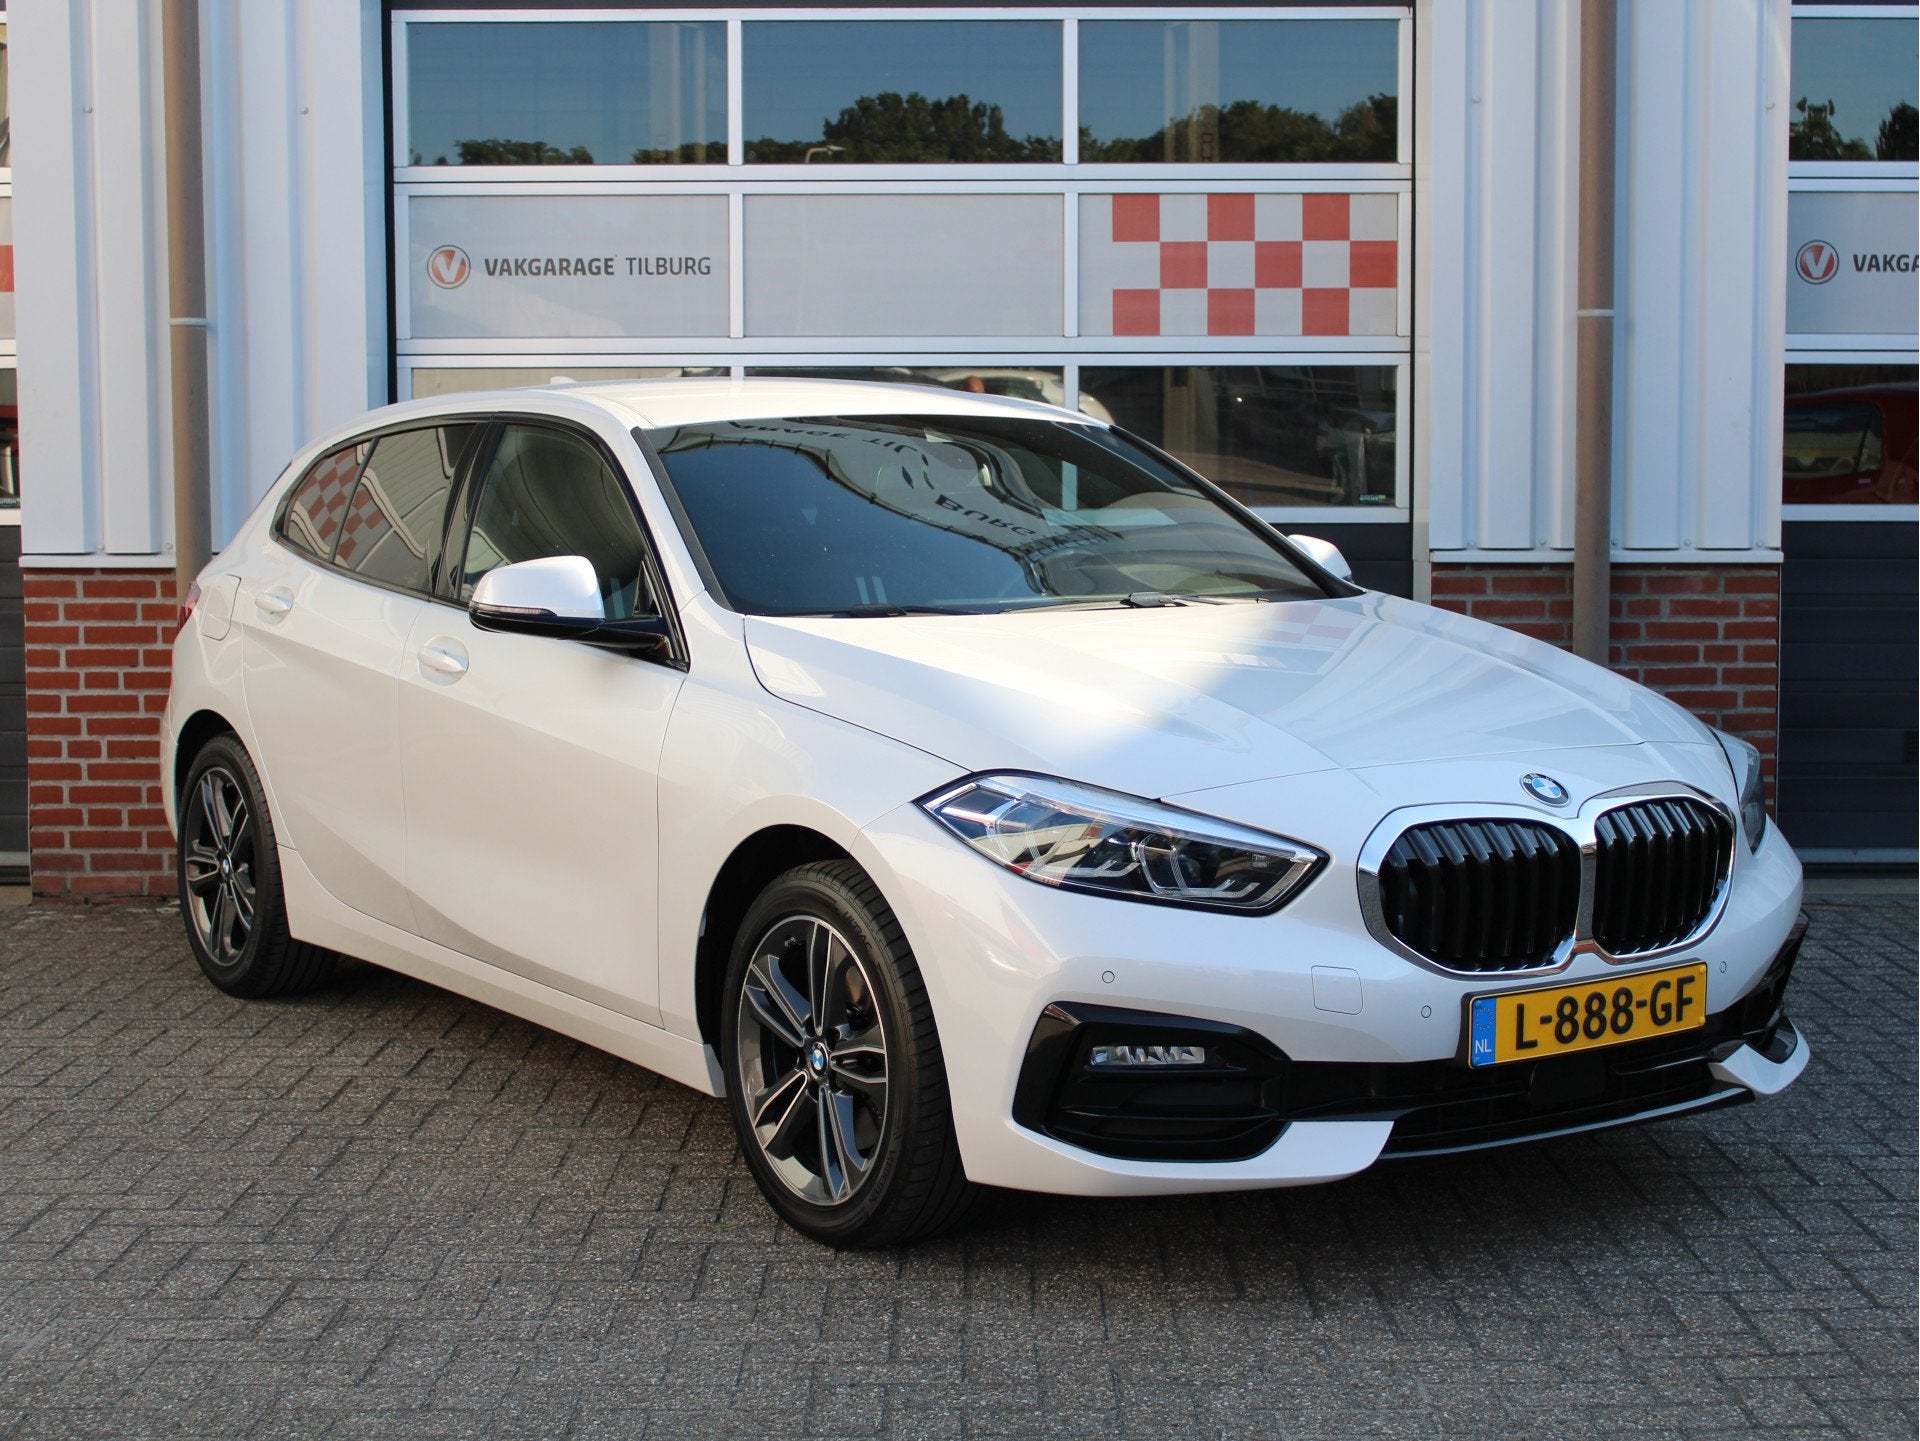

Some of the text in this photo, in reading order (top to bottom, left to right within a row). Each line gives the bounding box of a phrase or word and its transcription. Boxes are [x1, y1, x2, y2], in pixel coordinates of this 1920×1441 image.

[484, 256, 711, 276] VAKGARAGE TILBURG
[1515, 975, 1695, 1050] L-888-GF
[1474, 1038, 1492, 1053] NL
